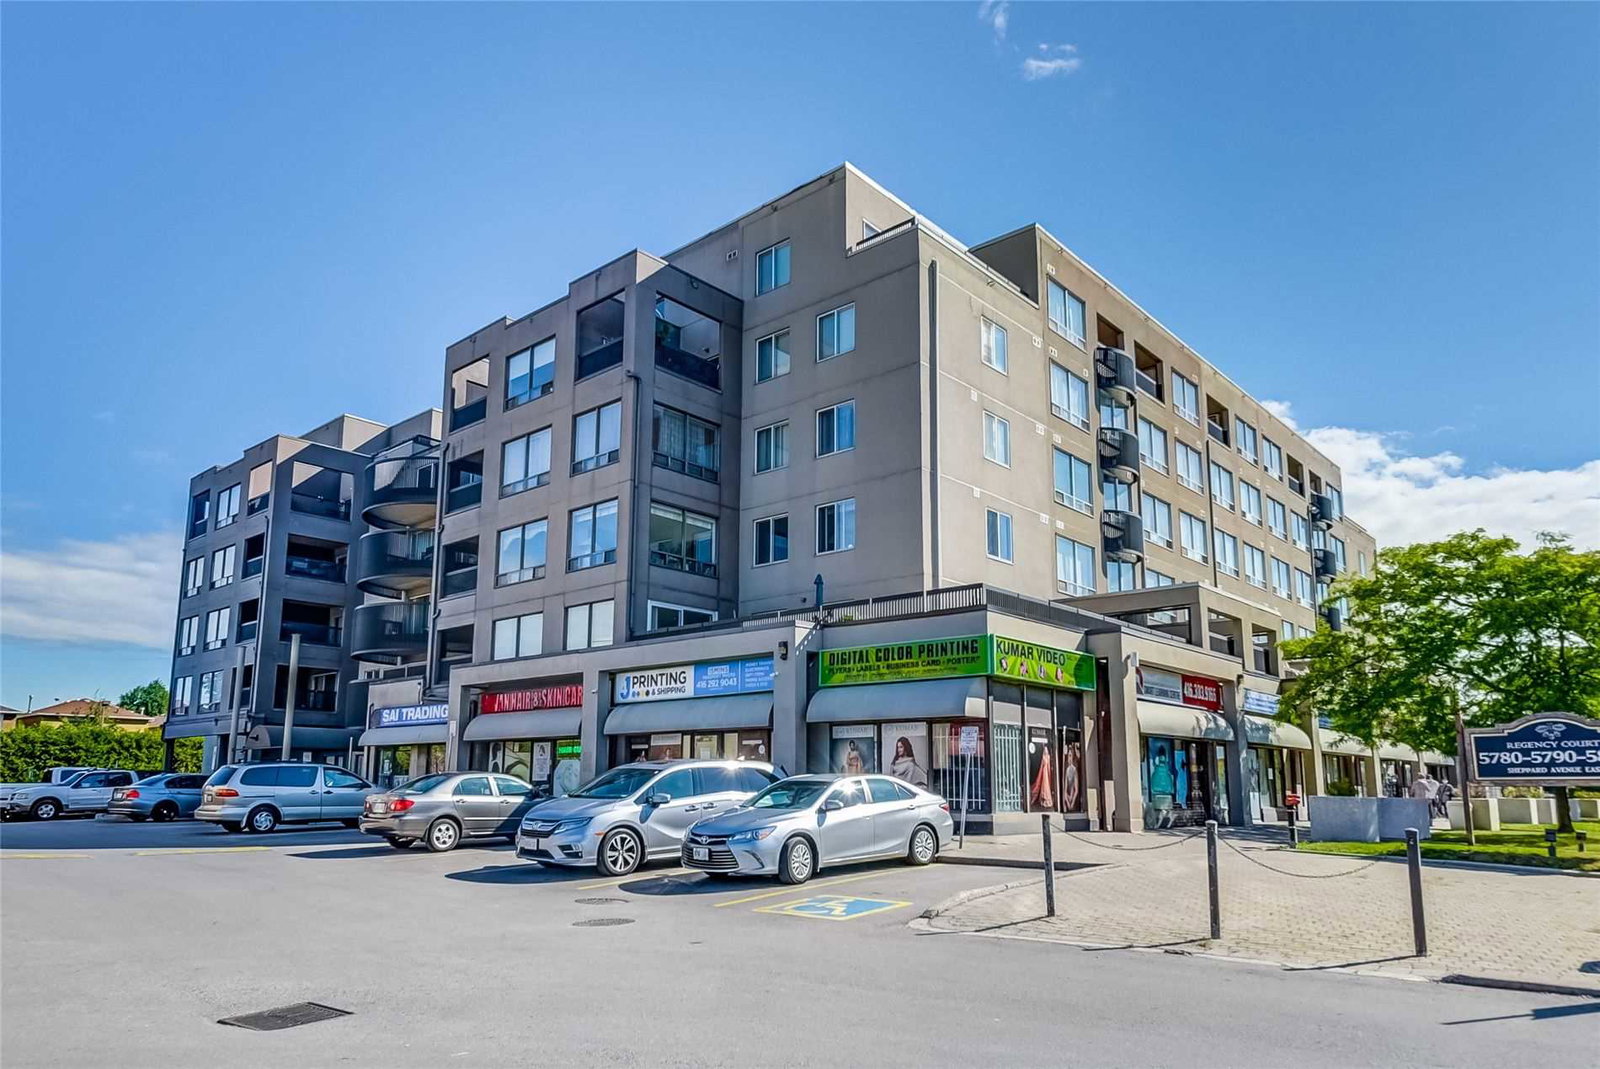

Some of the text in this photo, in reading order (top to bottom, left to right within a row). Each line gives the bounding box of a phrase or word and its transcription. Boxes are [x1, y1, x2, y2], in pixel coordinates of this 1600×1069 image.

[829, 640, 978, 666] DIGITAL COLOR PRINTING
[996, 640, 1034, 660] KUMAR
[1036, 648, 1066, 666] VIDEO
[856, 664, 880, 673] LABELS
[886, 661, 919, 671] BUSINESS
[921, 659, 941, 667] CARD
[632, 671, 687, 689] PRINTING
[696, 680, 707, 689] 416
[708, 679, 719, 688] 292
[720, 677, 737, 687] 9043
[510, 689, 533, 710] HAIR
[541, 688, 563, 708] SKIN
[657, 686, 686, 696] SHIPPING
[383, 704, 448, 722] SAI TRADING
[1506, 741, 1558, 749] REGENCY
[1507, 766, 1548, 774] SHEPPARD
